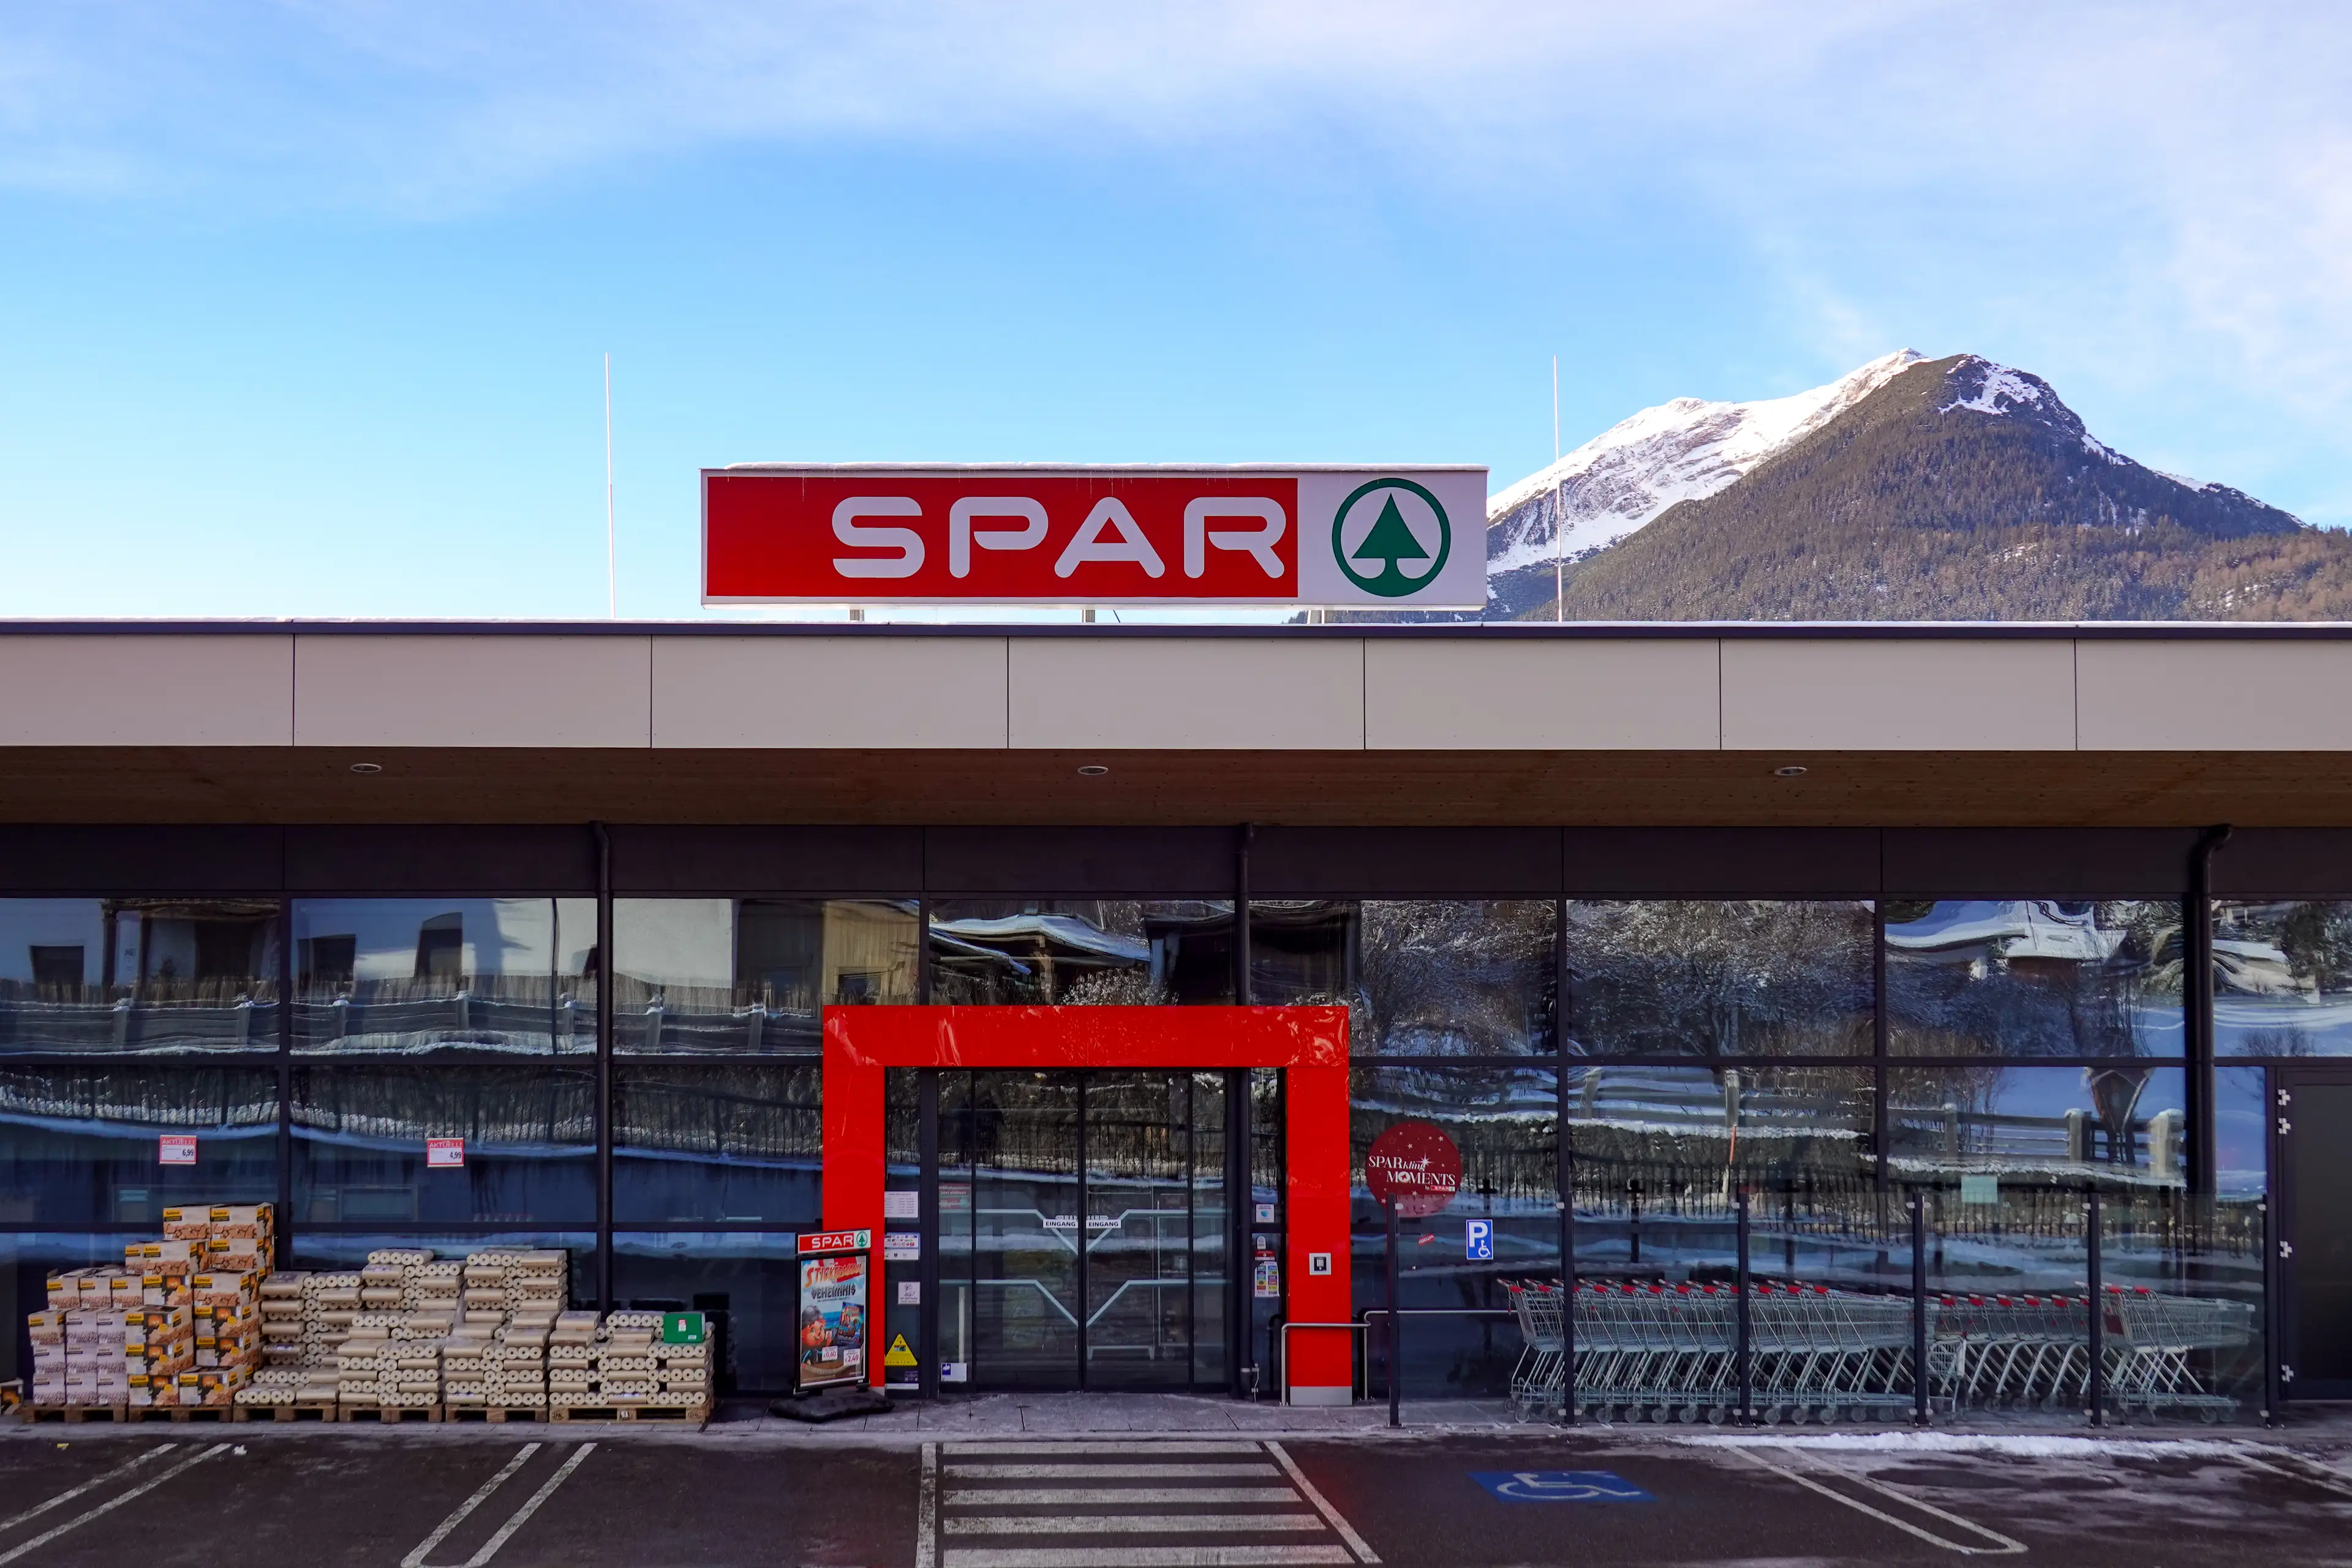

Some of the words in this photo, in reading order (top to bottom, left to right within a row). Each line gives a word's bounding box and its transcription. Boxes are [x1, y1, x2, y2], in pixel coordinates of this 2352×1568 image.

[832, 497, 1287, 578] SPAR
[183, 1148, 194, 1157] 6,99
[450, 1151, 462, 1159] 4,99
[1368, 1155, 1425, 1171] SPARkling
[1386, 1170, 1455, 1186] MOMENTS
[812, 1235, 853, 1249] SPAR
[1468, 1222, 1488, 1247] P
